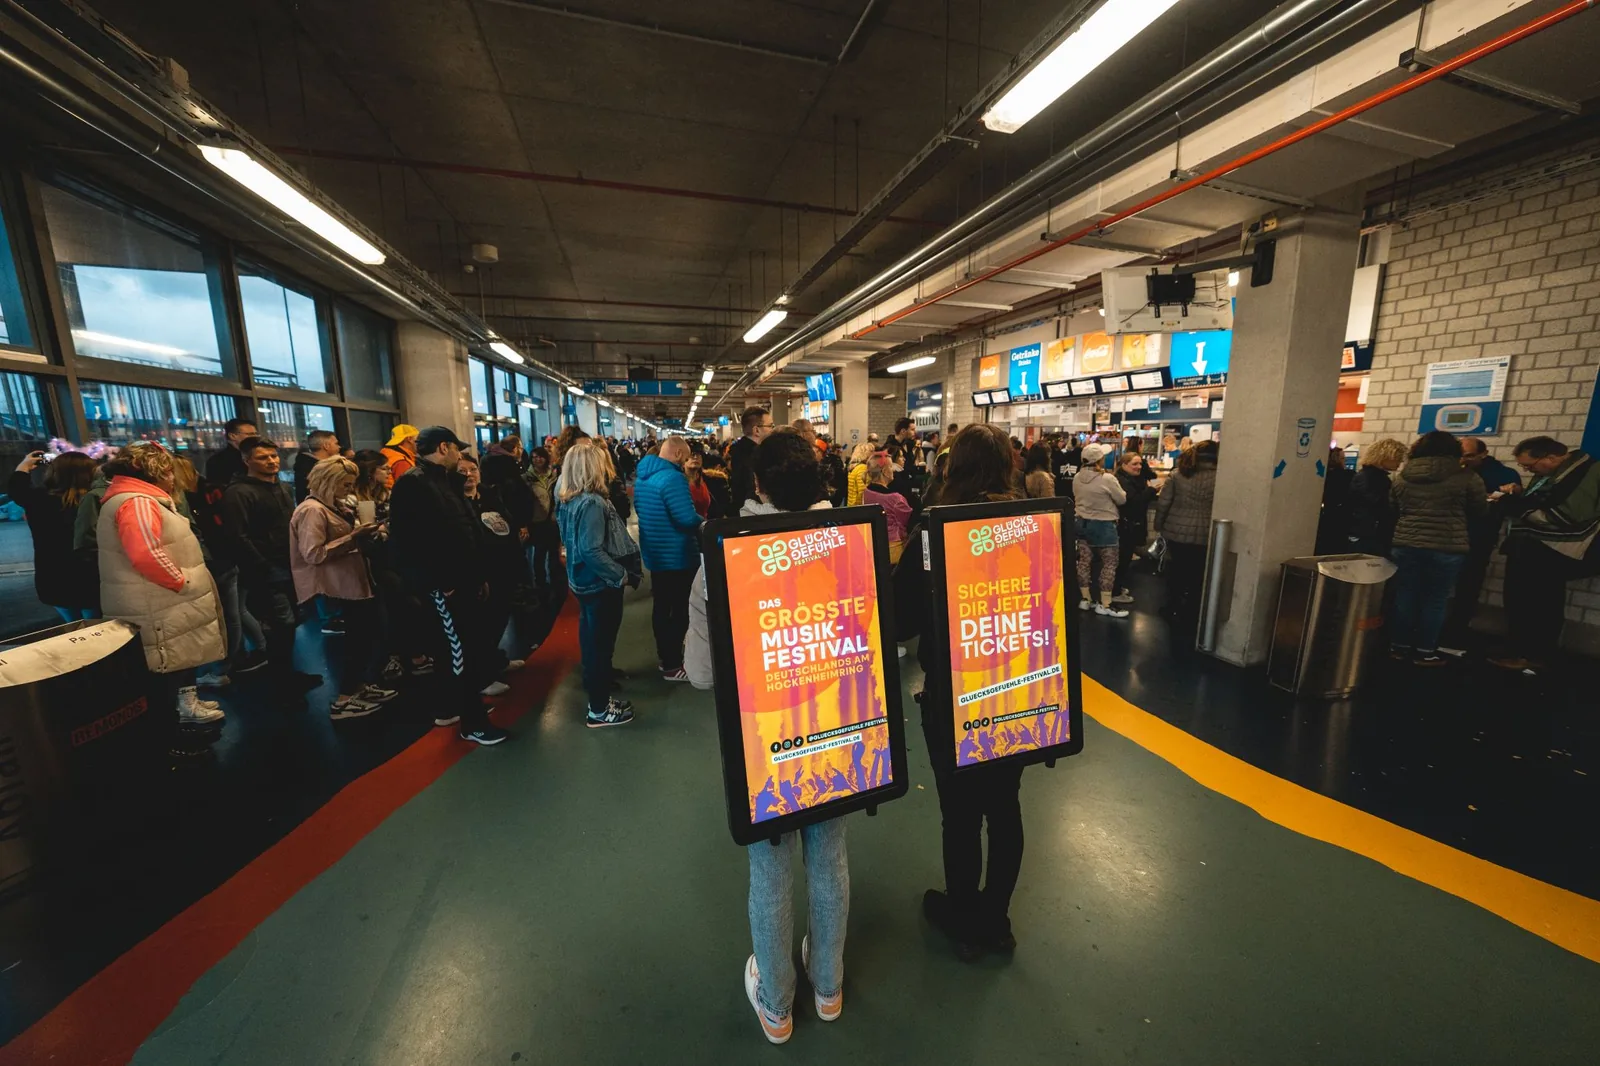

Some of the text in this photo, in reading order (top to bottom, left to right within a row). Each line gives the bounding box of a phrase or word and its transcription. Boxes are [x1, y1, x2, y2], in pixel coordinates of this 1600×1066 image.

[788, 526, 838, 550] GLÜCKS
[993, 515, 1034, 534] GLÜCKS
[995, 522, 1039, 543] GEFÜHLE
[791, 535, 846, 560] GEFÜHLE
[794, 555, 821, 566] FESTIVAL
[958, 576, 1031, 600] SICHERE
[759, 598, 782, 610] DAS
[759, 596, 866, 630] GRÖSSTE
[959, 592, 1042, 618] DIR JETZT
[761, 620, 844, 651] MUSIK-
[960, 611, 1031, 641] DEINE
[763, 635, 868, 671] FESTIVAL
[960, 629, 1050, 659] TICKETS!
[766, 654, 870, 683] DEUTSCHLANDS AM
[766, 664, 864, 692] HOCKENHEIMRING
[960, 666, 1060, 704] GLUECKSGEFUEHLE-FESTIVAL.DE
